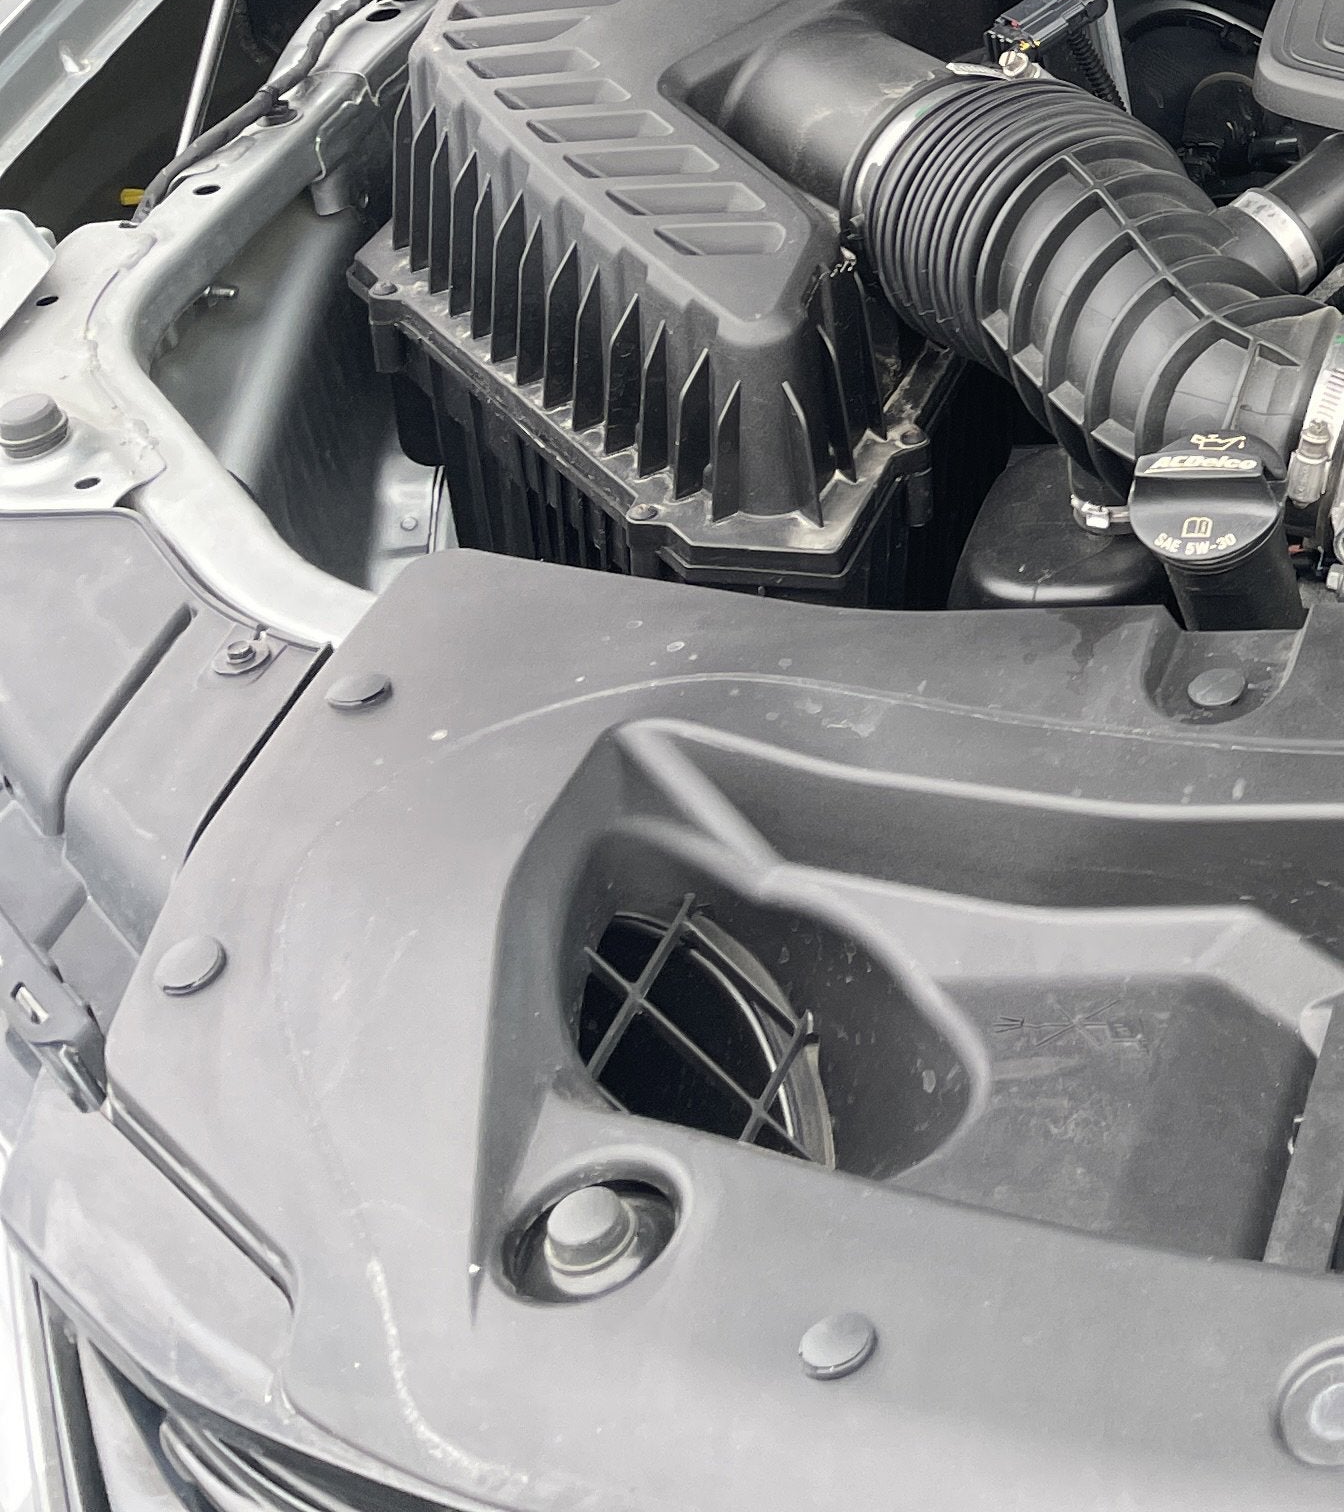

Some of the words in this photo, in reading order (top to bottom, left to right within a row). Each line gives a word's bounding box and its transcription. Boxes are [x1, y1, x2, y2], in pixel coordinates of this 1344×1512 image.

[1149, 454, 1258, 470] ACDelco
[1154, 532, 1183, 553] SAE
[1184, 533, 1237, 556] 5W-30
